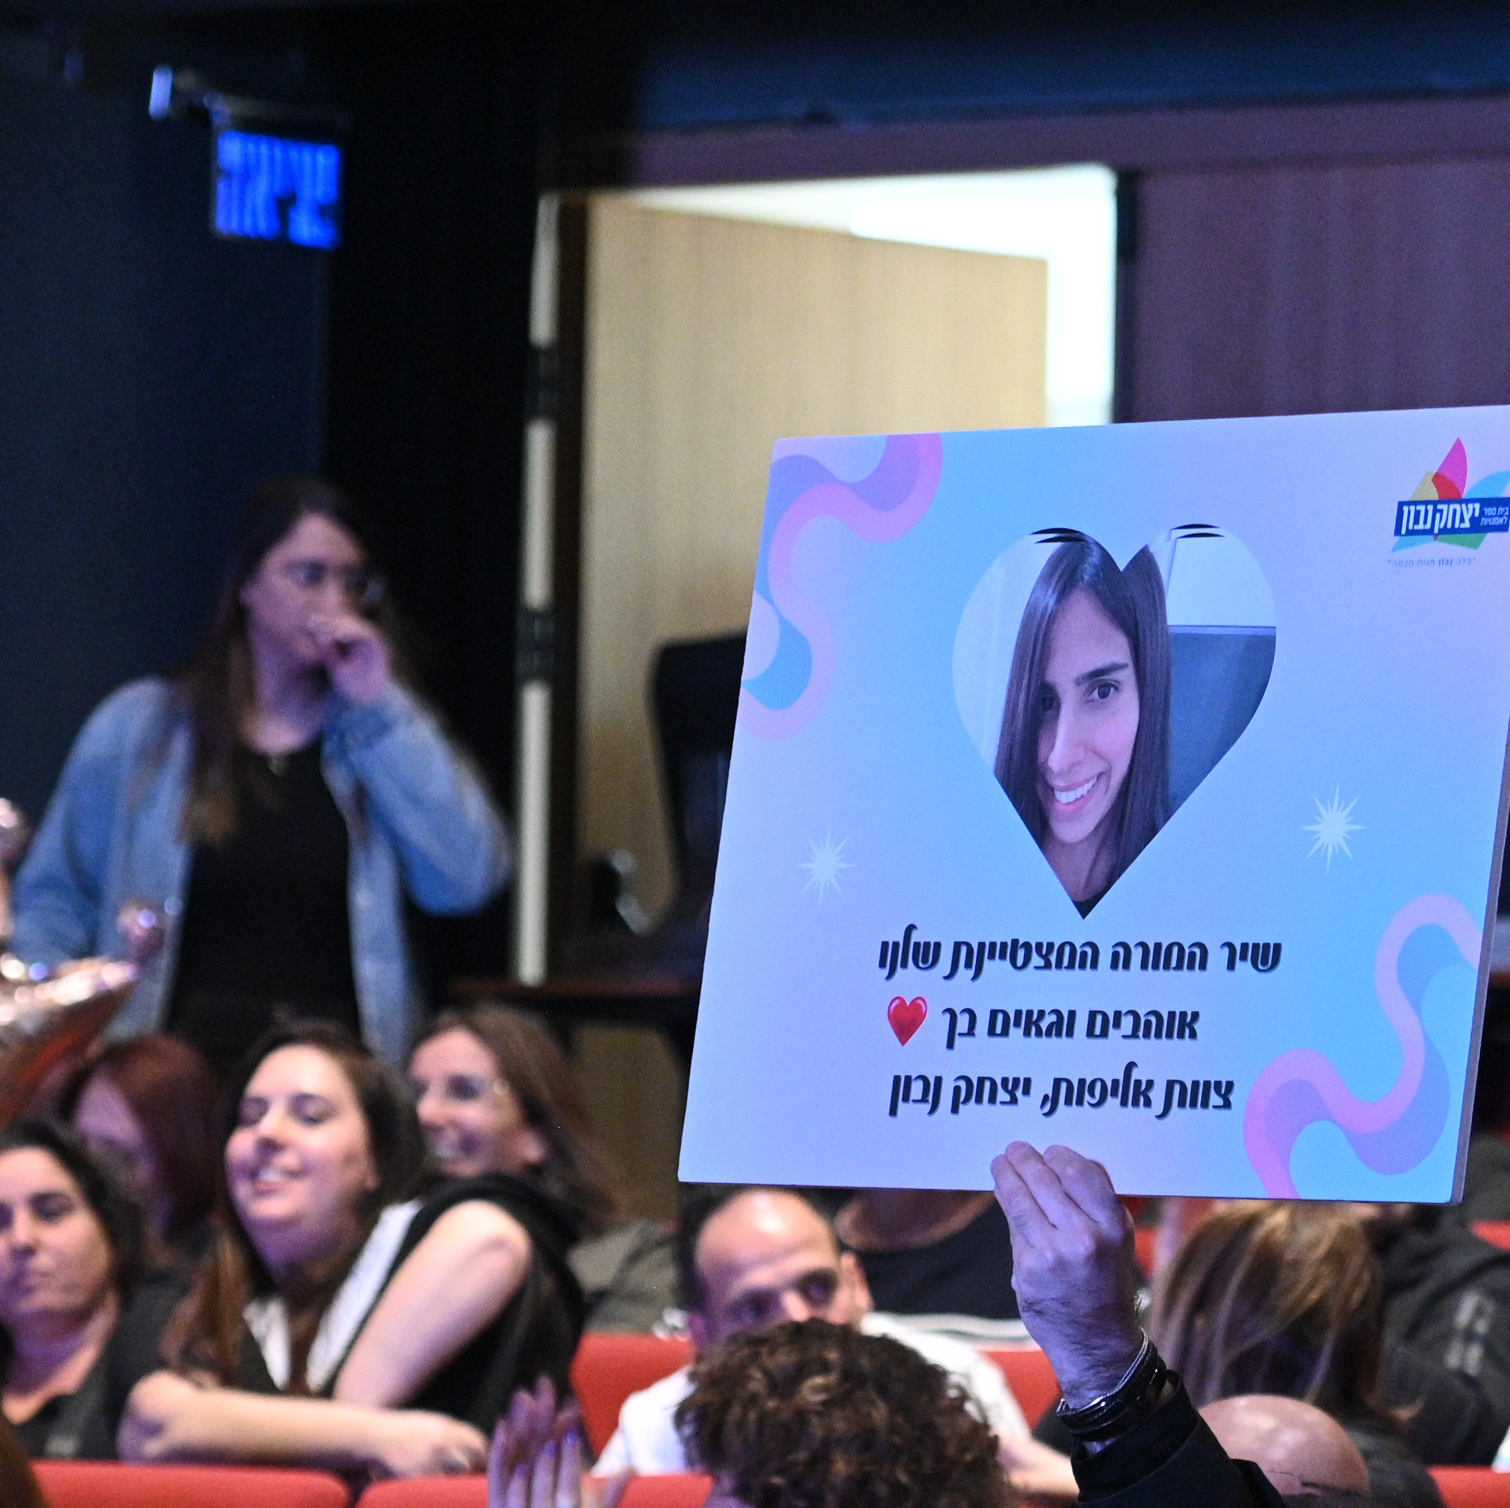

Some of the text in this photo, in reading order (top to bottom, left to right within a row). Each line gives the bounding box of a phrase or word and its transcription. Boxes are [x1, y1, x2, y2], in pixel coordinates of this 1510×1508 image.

[1401, 503, 1480, 535] יצחק נבון
[1483, 507, 1497, 516] ספר
[879, 924, 1282, 981] שיר המורה המצטיינת שלנו
[941, 1007, 1200, 1050] אוהבים וגאים בך
[889, 1061, 1235, 1119] צוות אליפות, יצחק נבון
